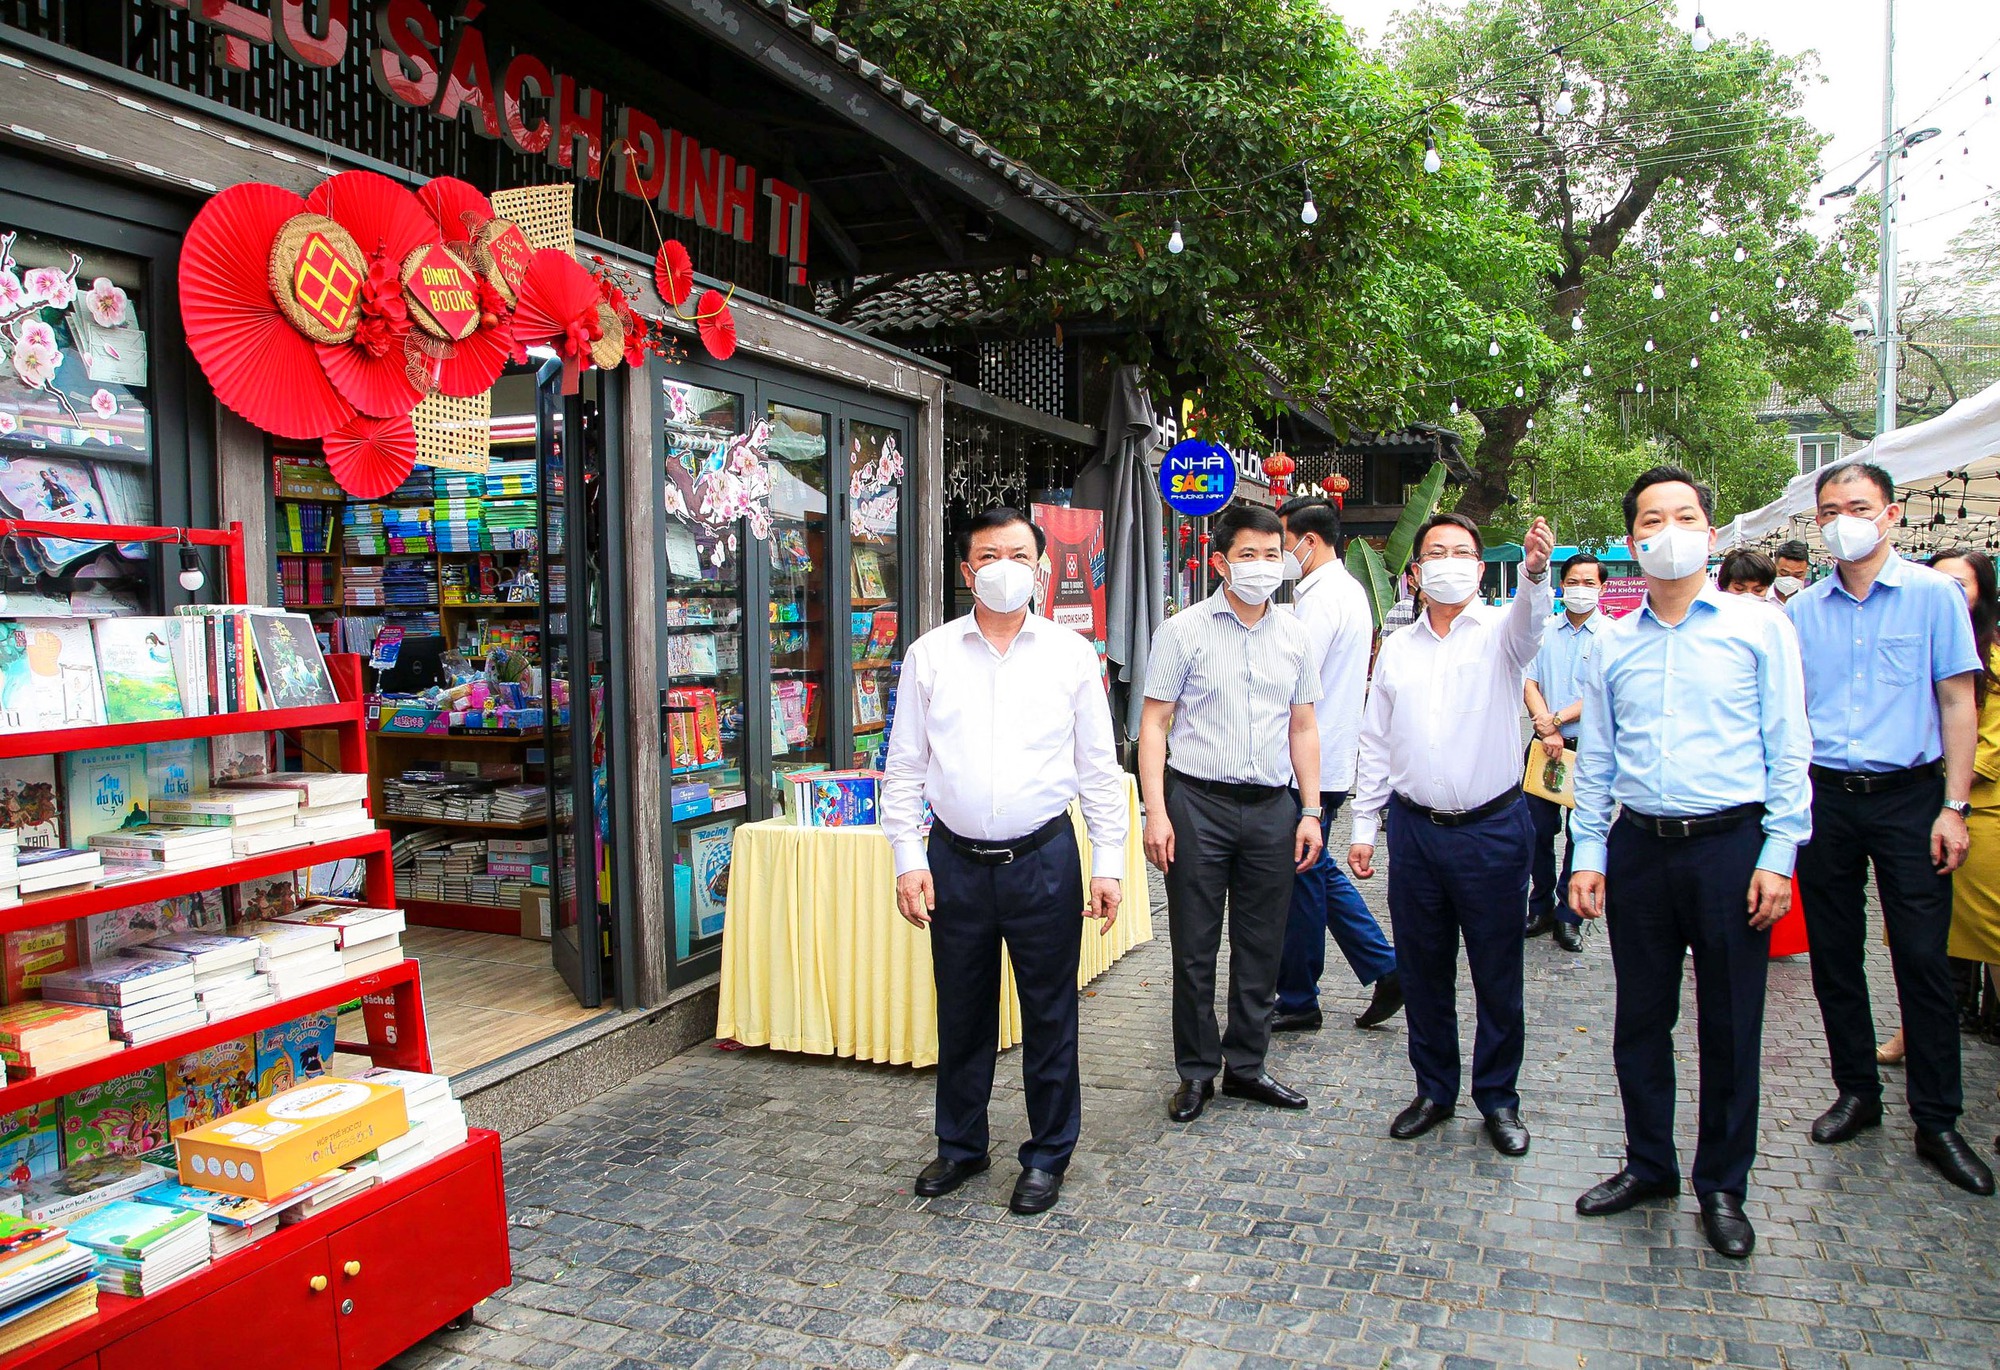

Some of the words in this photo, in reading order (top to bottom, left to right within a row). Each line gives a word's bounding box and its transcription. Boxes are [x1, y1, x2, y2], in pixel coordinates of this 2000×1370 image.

[371, 0, 604, 180] SÁCH
[764, 178, 810, 286] TỊ
[429, 290, 476, 312] BOOKS
[1154, 406, 1177, 446] HÀ
[1170, 452, 1224, 470] NHÀ
[1170, 470, 1224, 493] SÁCH
[1057, 613, 1090, 624] WORKSHOP
[699, 826, 729, 840] Racing
[363, 994, 384, 1005] Sách
[386, 1025, 397, 1044] 5
